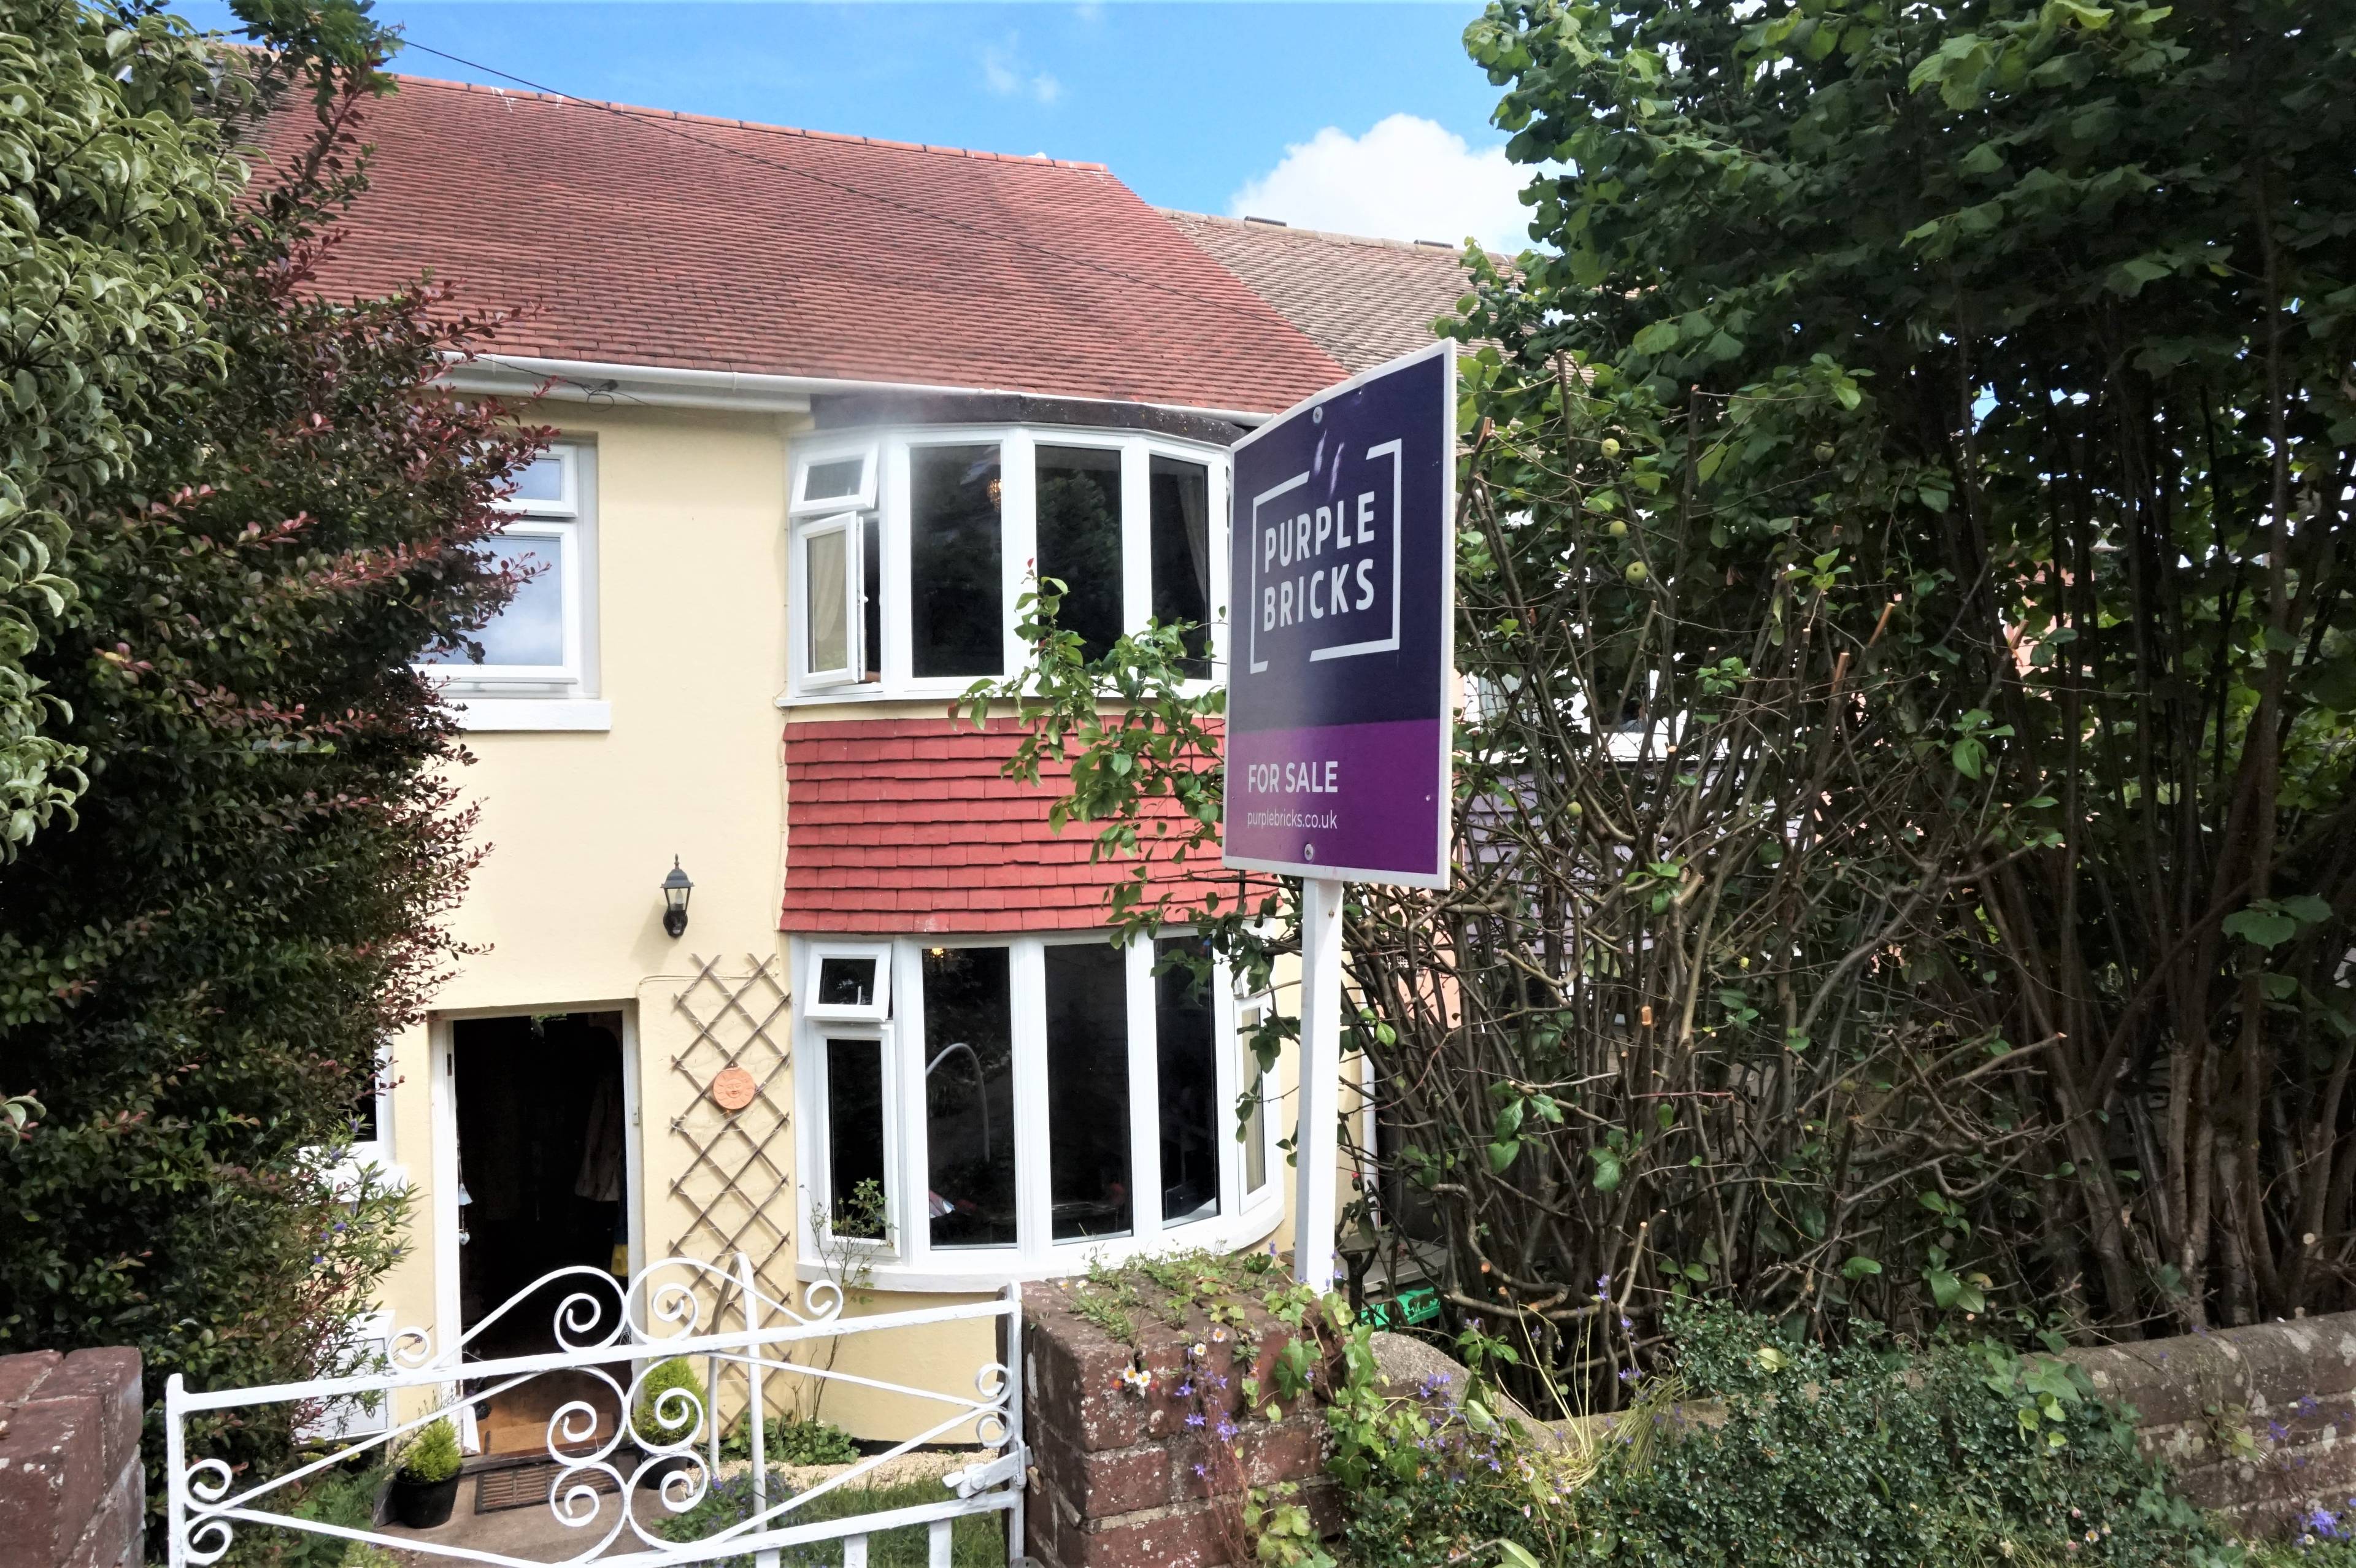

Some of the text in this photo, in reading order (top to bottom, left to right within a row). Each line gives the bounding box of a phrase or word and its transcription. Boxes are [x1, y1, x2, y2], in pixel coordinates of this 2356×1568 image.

[1265, 491, 1375, 573] PURPLE
[1263, 558, 1374, 632] BRICKS
[1248, 761, 1338, 793] FOR SALE
[1247, 808, 1338, 830] purplebricks.co.uk
